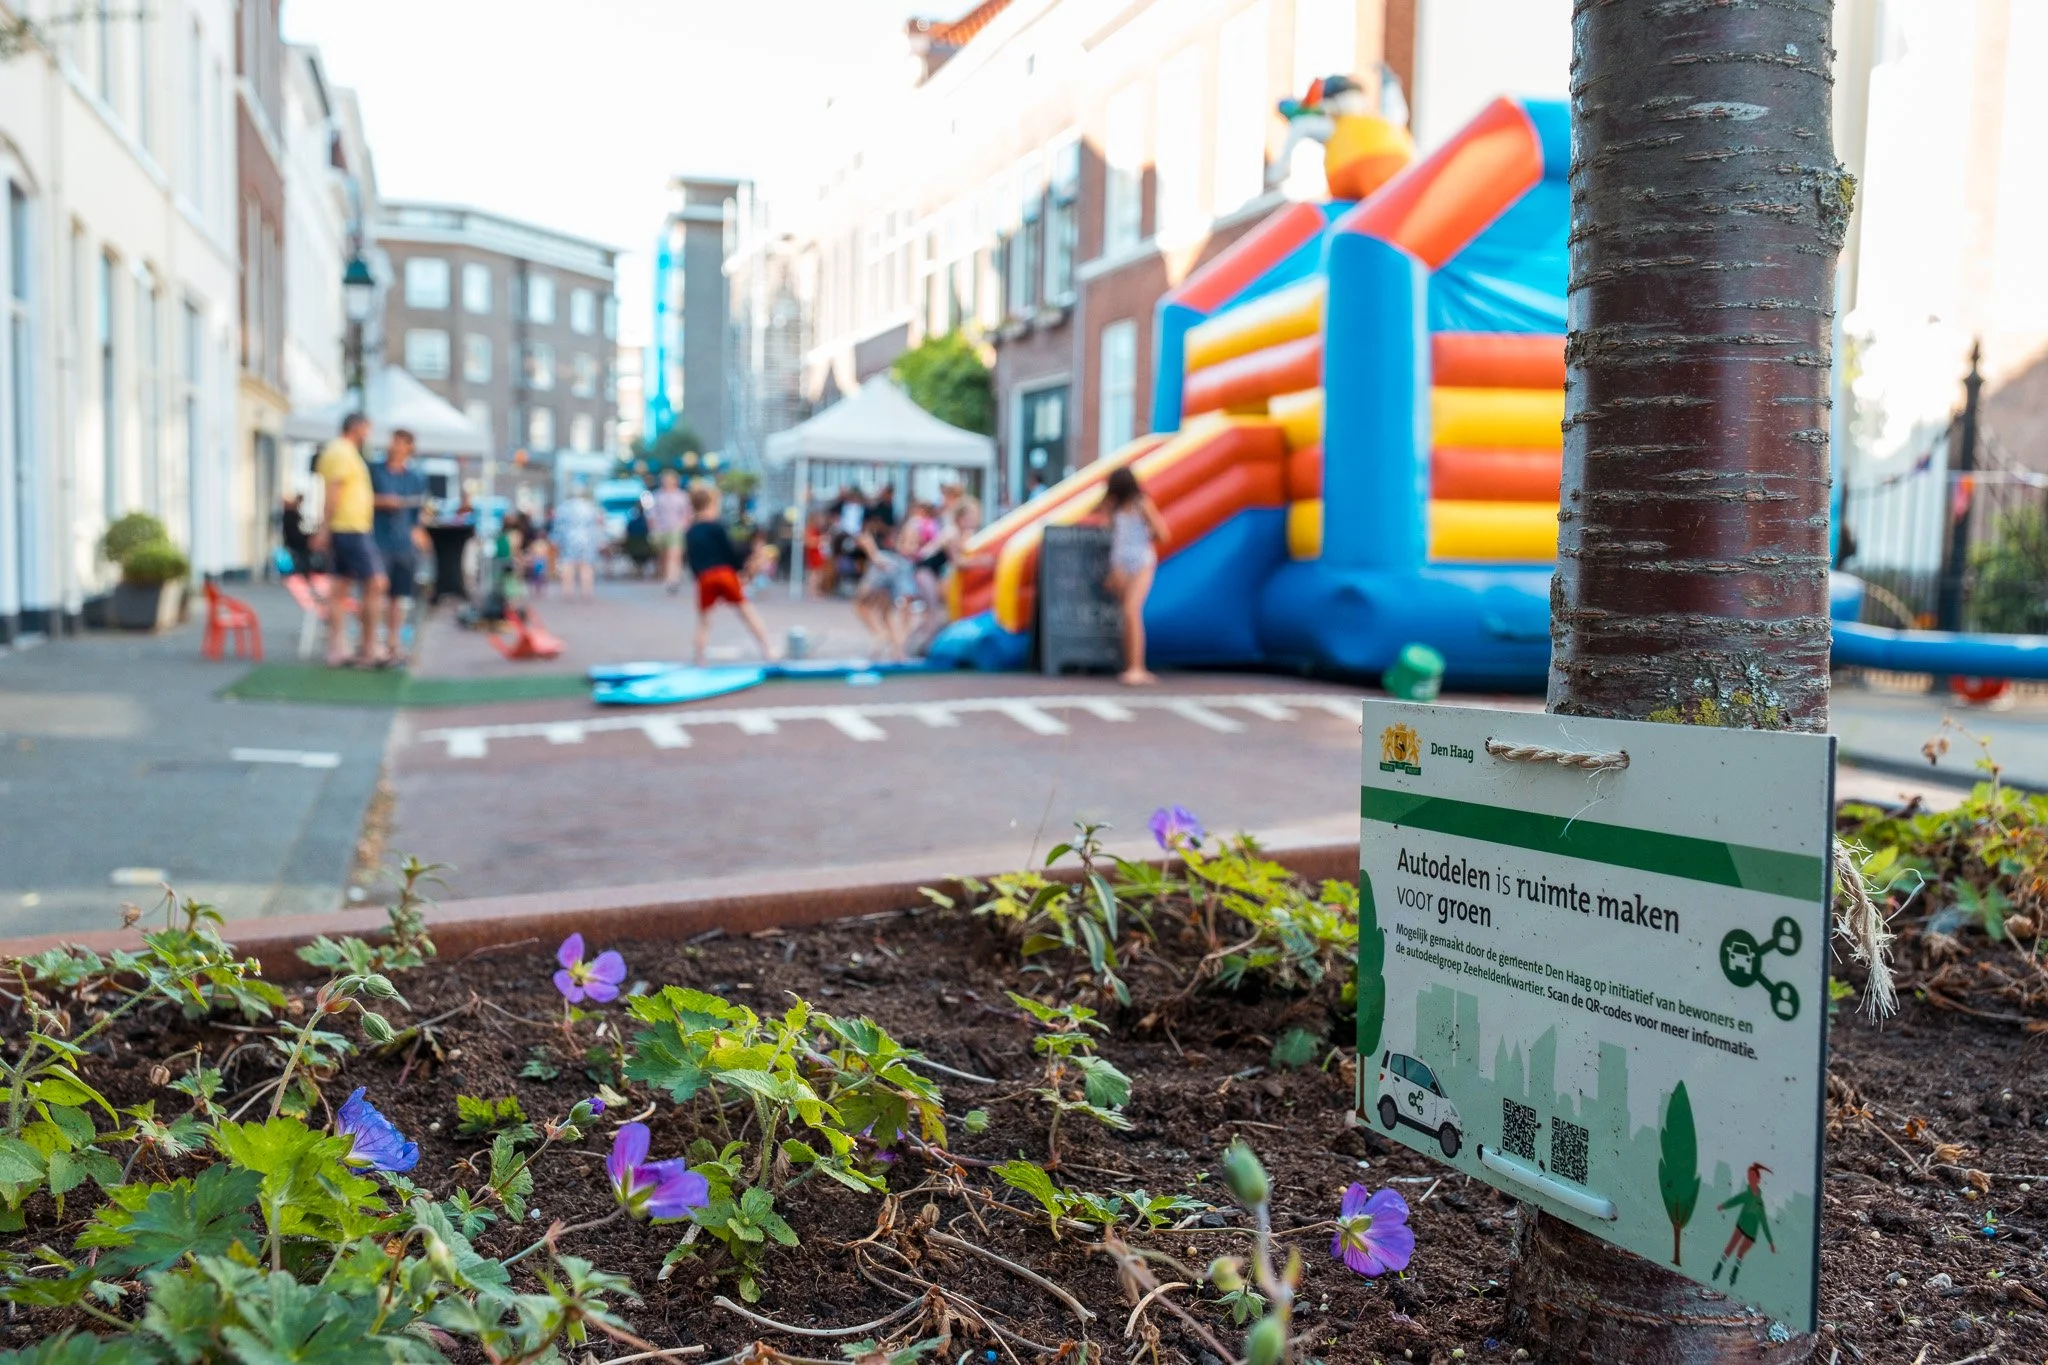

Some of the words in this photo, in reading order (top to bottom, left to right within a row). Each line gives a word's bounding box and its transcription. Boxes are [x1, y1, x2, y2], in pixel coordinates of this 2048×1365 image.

[1431, 743, 1448, 756] Den
[1450, 745, 1474, 763] Haag
[1397, 848, 1490, 891] Autodelen
[1496, 867, 1511, 895] is
[1517, 875, 1591, 913] ruimte
[1597, 894, 1679, 934] maken
[1397, 886, 1433, 912] voor
[1438, 896, 1491, 927] groen
[1396, 923, 1428, 944] Mogelijk
[1430, 934, 1464, 952] gemaakt
[1466, 942, 1485, 958] door
[1486, 947, 1497, 961] de
[1498, 954, 1543, 975] gemeente
[1545, 964, 1564, 980] Den
[1566, 970, 1591, 992] Haag
[1593, 980, 1606, 996] op
[1609, 981, 1654, 1006] initiatief
[1656, 997, 1675, 1012] van
[1679, 999, 1735, 1029] bewoners
[1738, 1020, 1753, 1034] en
[1396, 942, 1405, 954] de
[1406, 947, 1462, 974] autodeelgroep
[1463, 961, 1546, 997] Zeeheldenkwartier.
[1547, 986, 1569, 1004] Scan
[1571, 993, 1584, 1008] de
[1585, 998, 1632, 1023] QR-codes
[1634, 1014, 1659, 1030] voor
[1660, 1021, 1689, 1040] meer
[1692, 1027, 1758, 1060] informatie.
